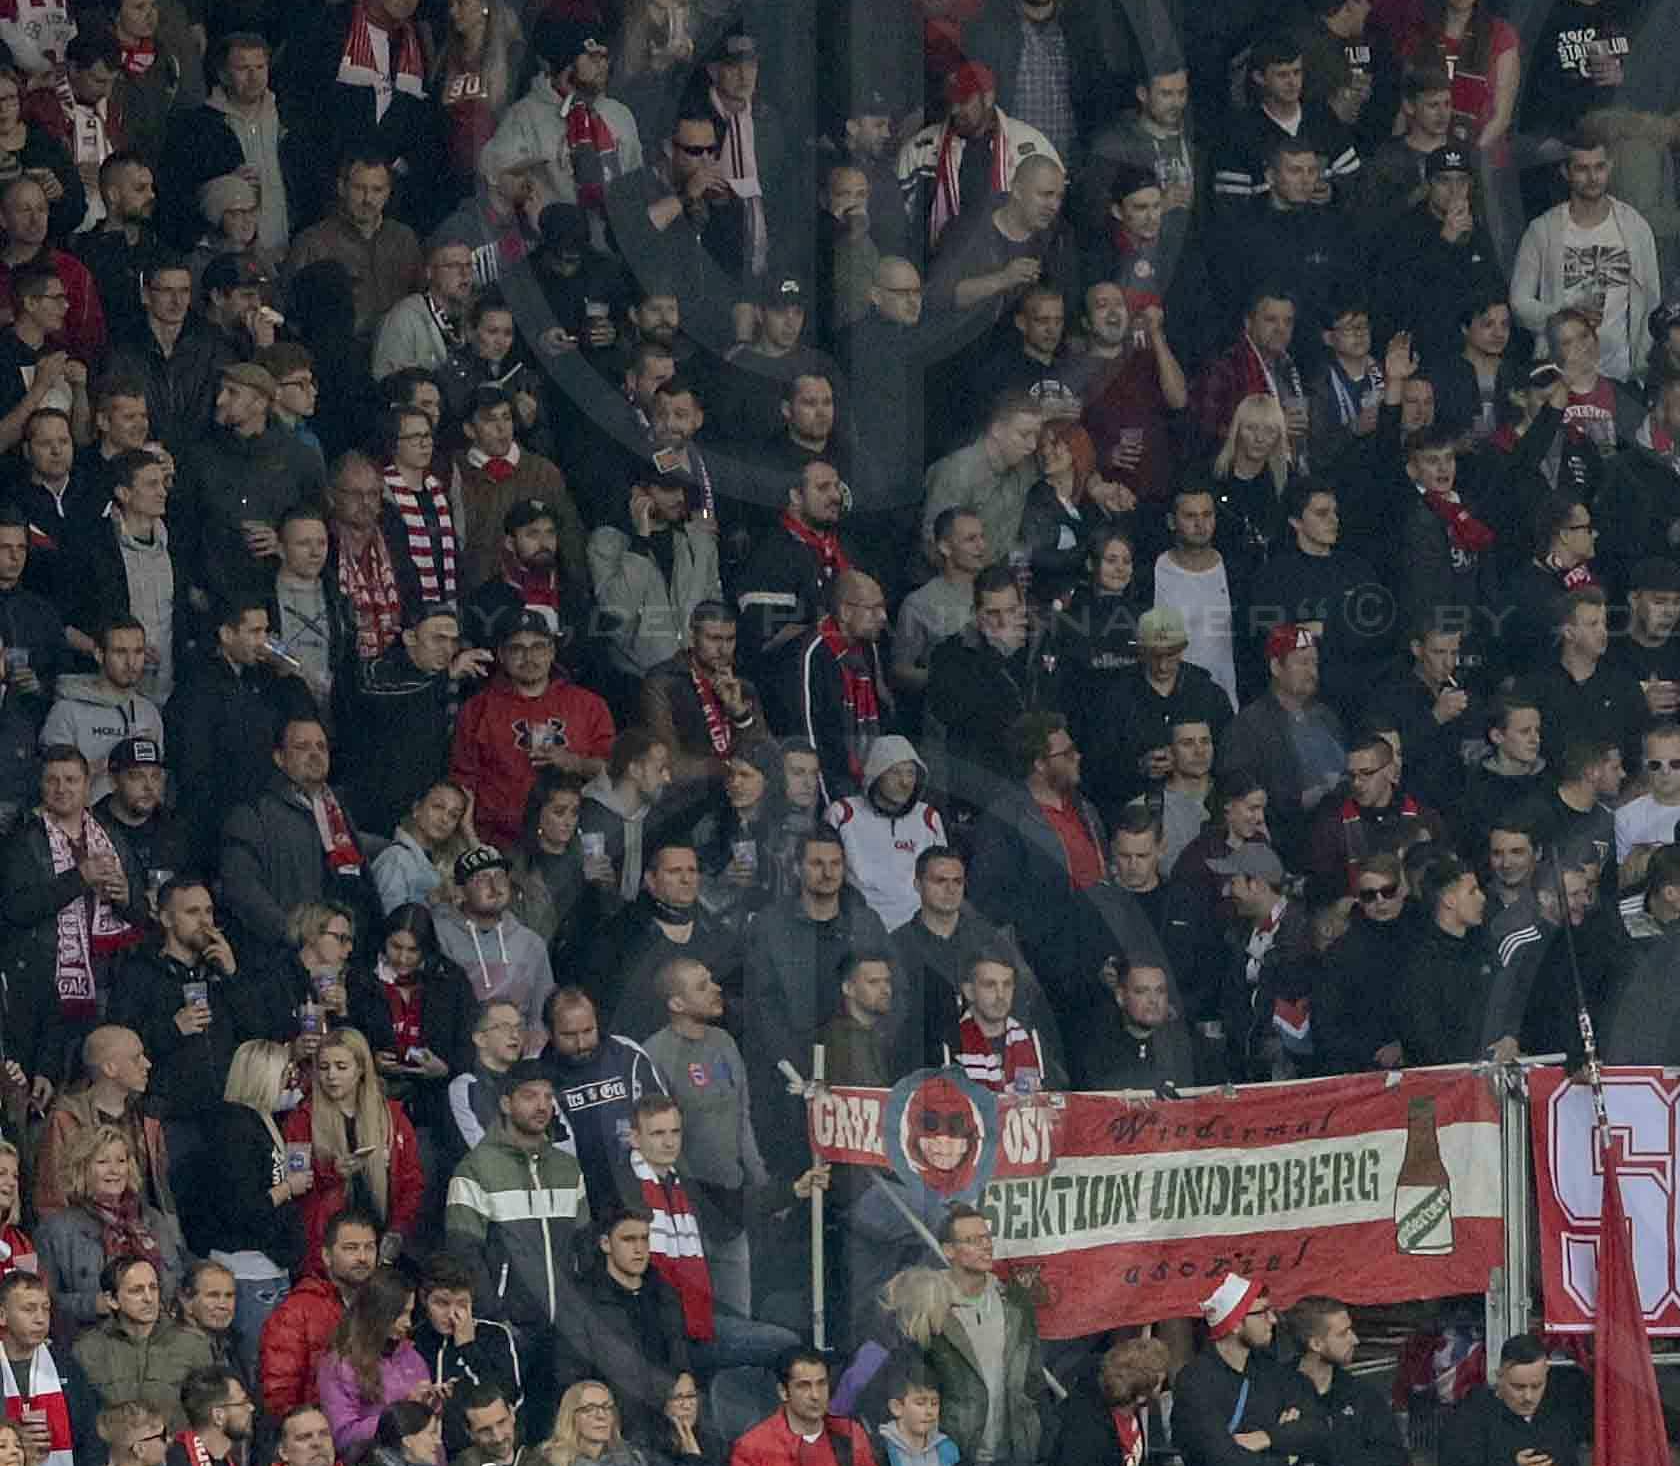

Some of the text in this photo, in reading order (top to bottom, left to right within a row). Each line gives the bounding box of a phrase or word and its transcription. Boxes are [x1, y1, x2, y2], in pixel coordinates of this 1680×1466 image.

[57, 978, 89, 995] GAK
[1001, 1105, 1053, 1165] OST
[976, 1148, 1383, 1241] SEKTION UNDERBERG
